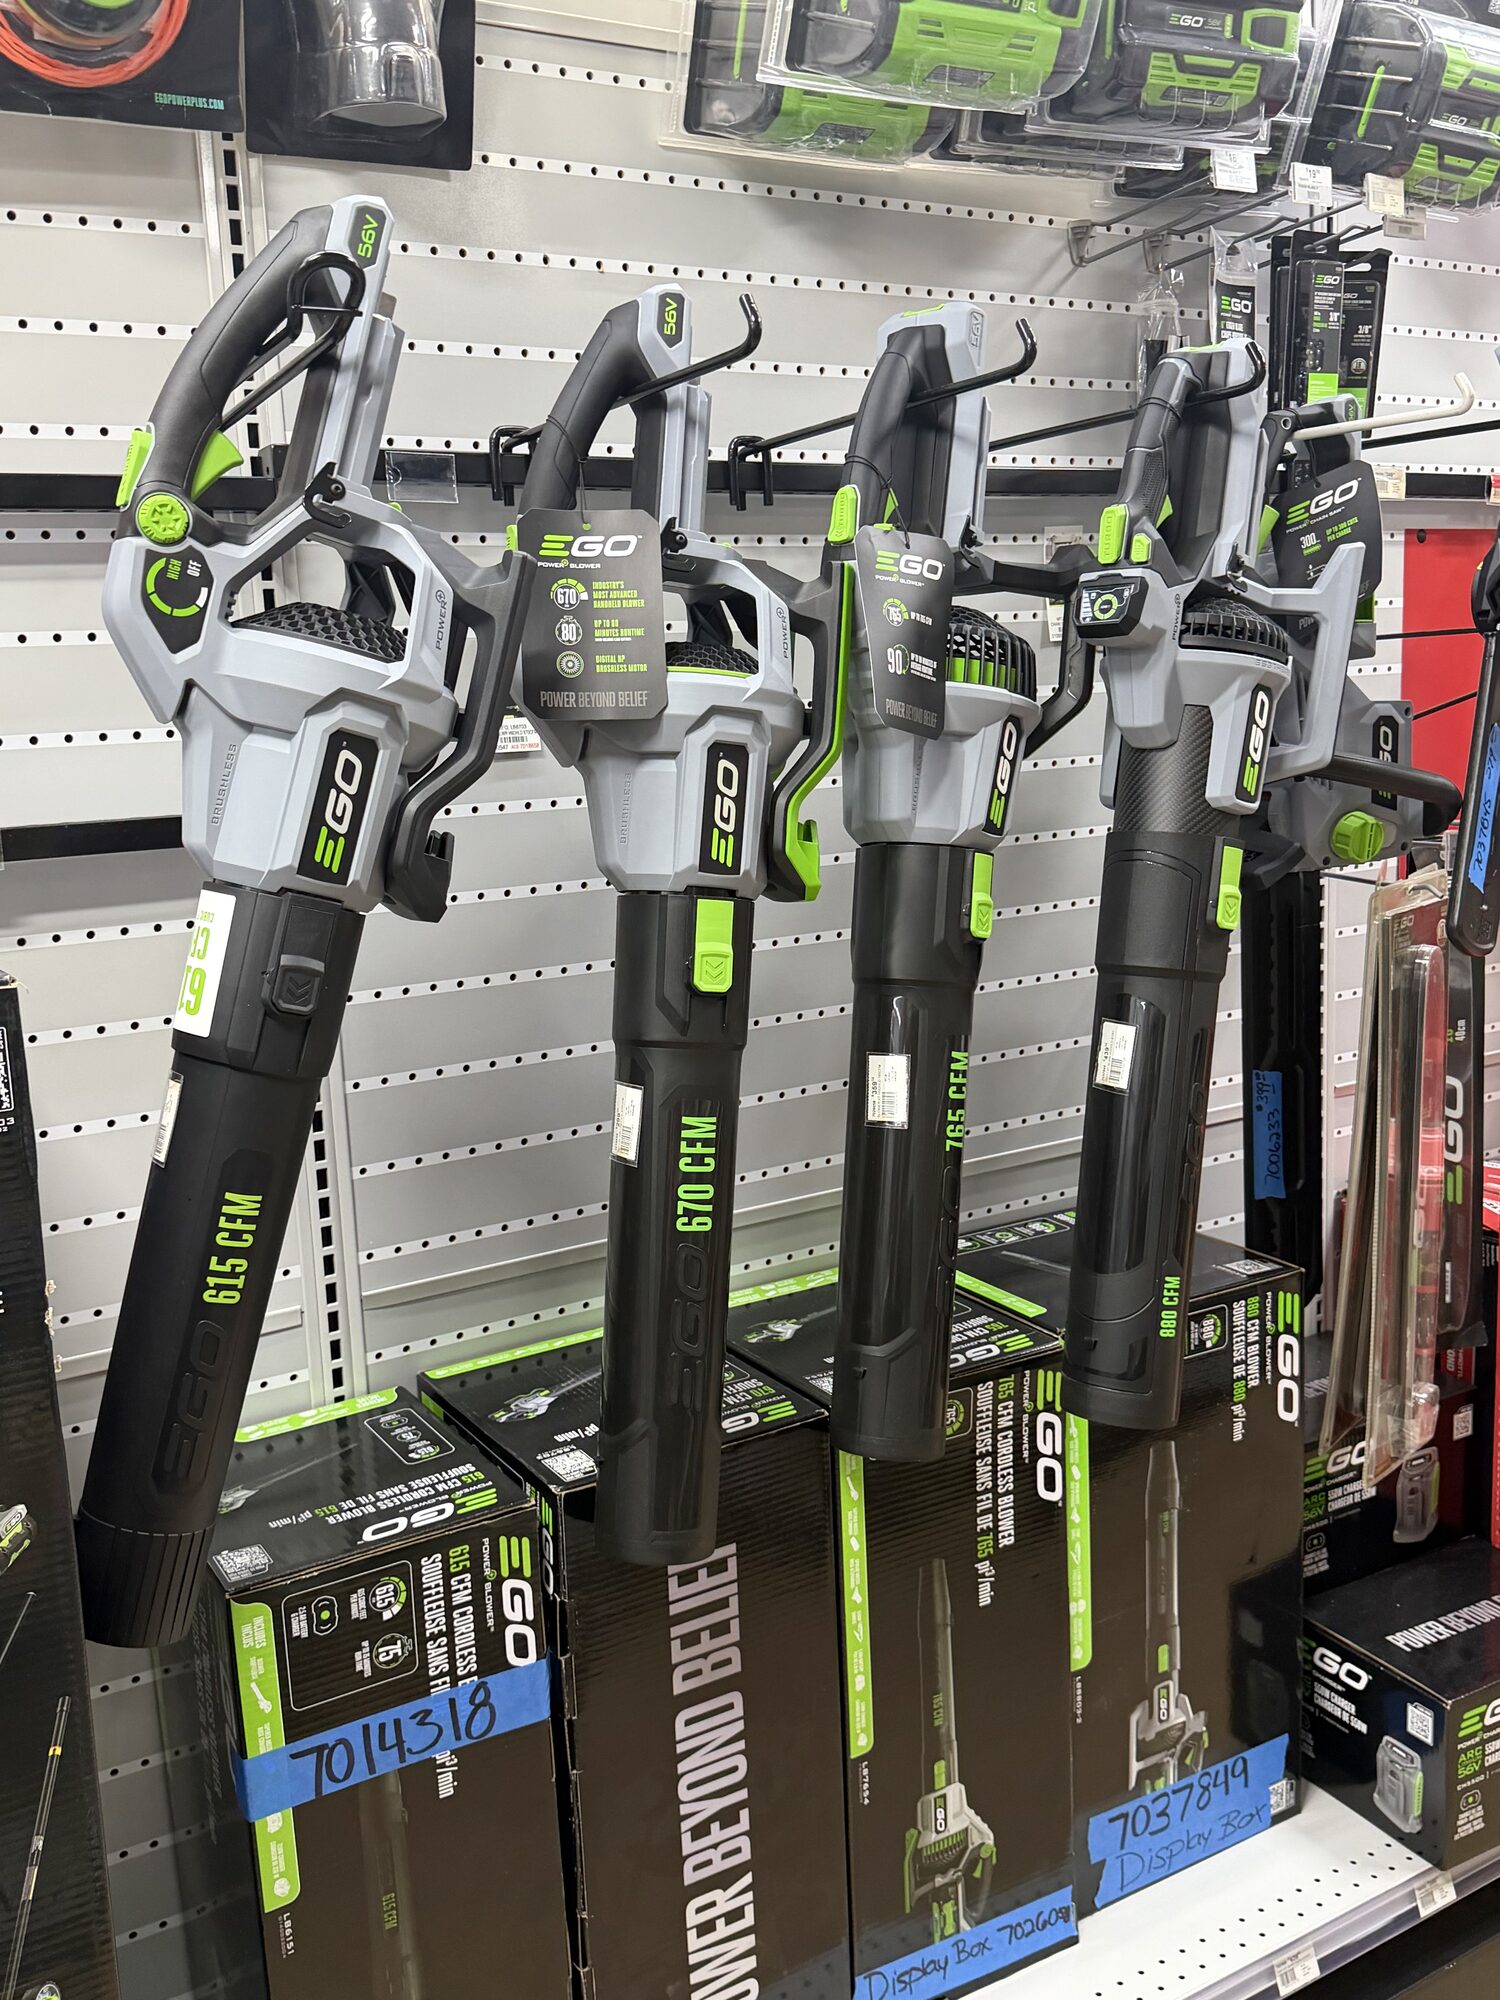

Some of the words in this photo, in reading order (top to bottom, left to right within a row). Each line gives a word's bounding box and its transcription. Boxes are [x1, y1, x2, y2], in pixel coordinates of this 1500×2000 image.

[1168, 11, 1204, 29] EGO
[154, 92, 225, 111] EGOPOWERPLUS.COM
[357, 213, 380, 259] 56V
[1315, 274, 1340, 285] EGO
[664, 297, 680, 336] 56V
[1221, 295, 1253, 314] EGO
[1286, 479, 1359, 525] EGO
[539, 534, 640, 558] EGO
[1299, 532, 1317, 549] 300
[166, 558, 182, 581] HIGH
[186, 559, 203, 578] OFF
[875, 550, 944, 581] EGO
[556, 588, 577, 605] 670
[900, 578, 922, 587] BLOWER
[887, 604, 902, 622] 765
[561, 623, 576, 641] 80
[887, 647, 903, 676] 90
[540, 690, 577, 708] POWER
[577, 690, 617, 708] BEYOND
[618, 690, 649, 707] BELIEF
[885, 698, 905, 719] POWER
[923, 708, 938, 729] BELIEF
[1242, 690, 1269, 796] EGO
[210, 743, 238, 826] BRUSHLESS
[990, 721, 1017, 829] EGO
[313, 748, 364, 875] EGO
[711, 758, 740, 868] EGO
[948, 1050, 969, 1101] CFM
[678, 1116, 717, 1173] CFM
[945, 1108, 966, 1152] 765
[1264, 1107, 1280, 1186] 7006233
[215, 1191, 263, 1248] CFM
[675, 1183, 715, 1232] 670
[202, 1256, 249, 1305] 615
[1162, 1276, 1181, 1306] CFM
[1246, 1295, 1260, 1318] 880
[1159, 1310, 1177, 1338] 880
[1202, 1317, 1215, 1339] 880
[1232, 1299, 1246, 1362] SOUFFLEUSE
[1246, 1319, 1260, 1343] CFM
[1232, 1363, 1246, 1379] DE
[1246, 1344, 1260, 1388] BLOWER
[1265, 1335, 1273, 1382] BLOWER
[1277, 1290, 1300, 1423] EGO
[749, 1385, 776, 1397] 670
[997, 1373, 1015, 1398] 765
[1232, 1379, 1247, 1403] 880
[721, 1401, 798, 1434] EG
[975, 1380, 994, 1455] SOUFFLEUSE
[997, 1400, 1014, 1429] CFM
[1022, 1413, 1030, 1458] BLOWER
[1036, 1368, 1063, 1502] EGO
[409, 1463, 476, 1490] SOUFFLEUSE
[975, 1457, 993, 1491] SANS
[996, 1429, 1014, 1494] CORDLESS
[376, 1480, 409, 1499] SANS
[436, 1475, 462, 1493] CFM
[460, 1469, 486, 1486] 615
[338, 1495, 356, 1511] DE
[355, 1487, 375, 1502] FIL
[384, 1483, 437, 1507] CORDLESS
[401, 1494, 450, 1513] BLOWER
[976, 1492, 993, 1514] FIL
[315, 1502, 338, 1519] 615
[326, 1500, 381, 1525] BLOWER
[361, 1487, 498, 1543] EGO
[976, 1515, 993, 1533] DE
[998, 1496, 1016, 1549] BLOWER
[449, 1543, 470, 1573] 615
[976, 1532, 994, 1559] 765
[375, 1584, 395, 1610] 615
[420, 1552, 446, 1630] SOUFFLEUSE
[451, 1573, 472, 1605] CFM
[499, 1535, 538, 1667] EGO
[483, 1581, 495, 1631] BLOWER
[241, 1622, 252, 1649] INCLUS
[252, 1615, 267, 1649] INCLUDES
[1385, 1619, 1453, 1652] POWER
[1439, 1600, 1493, 1638] BEYOND
[377, 1639, 402, 1664] 75
[425, 1631, 449, 1674] SANS
[452, 1605, 478, 1680] CORDLESS
[289, 1680, 497, 1799] 7014318
[1458, 1745, 1483, 1763] ARC
[1458, 1760, 1482, 1779] 56V
[674, 1690, 753, 1887] BEYOND
[1108, 1756, 1249, 1850] 7037849
[1116, 1828, 1213, 1893] Display
[1217, 1803, 1267, 1842] Box
[282, 1912, 295, 1956] LB6151
[863, 1955, 949, 2000] Display
[952, 1936, 993, 1966] Box
